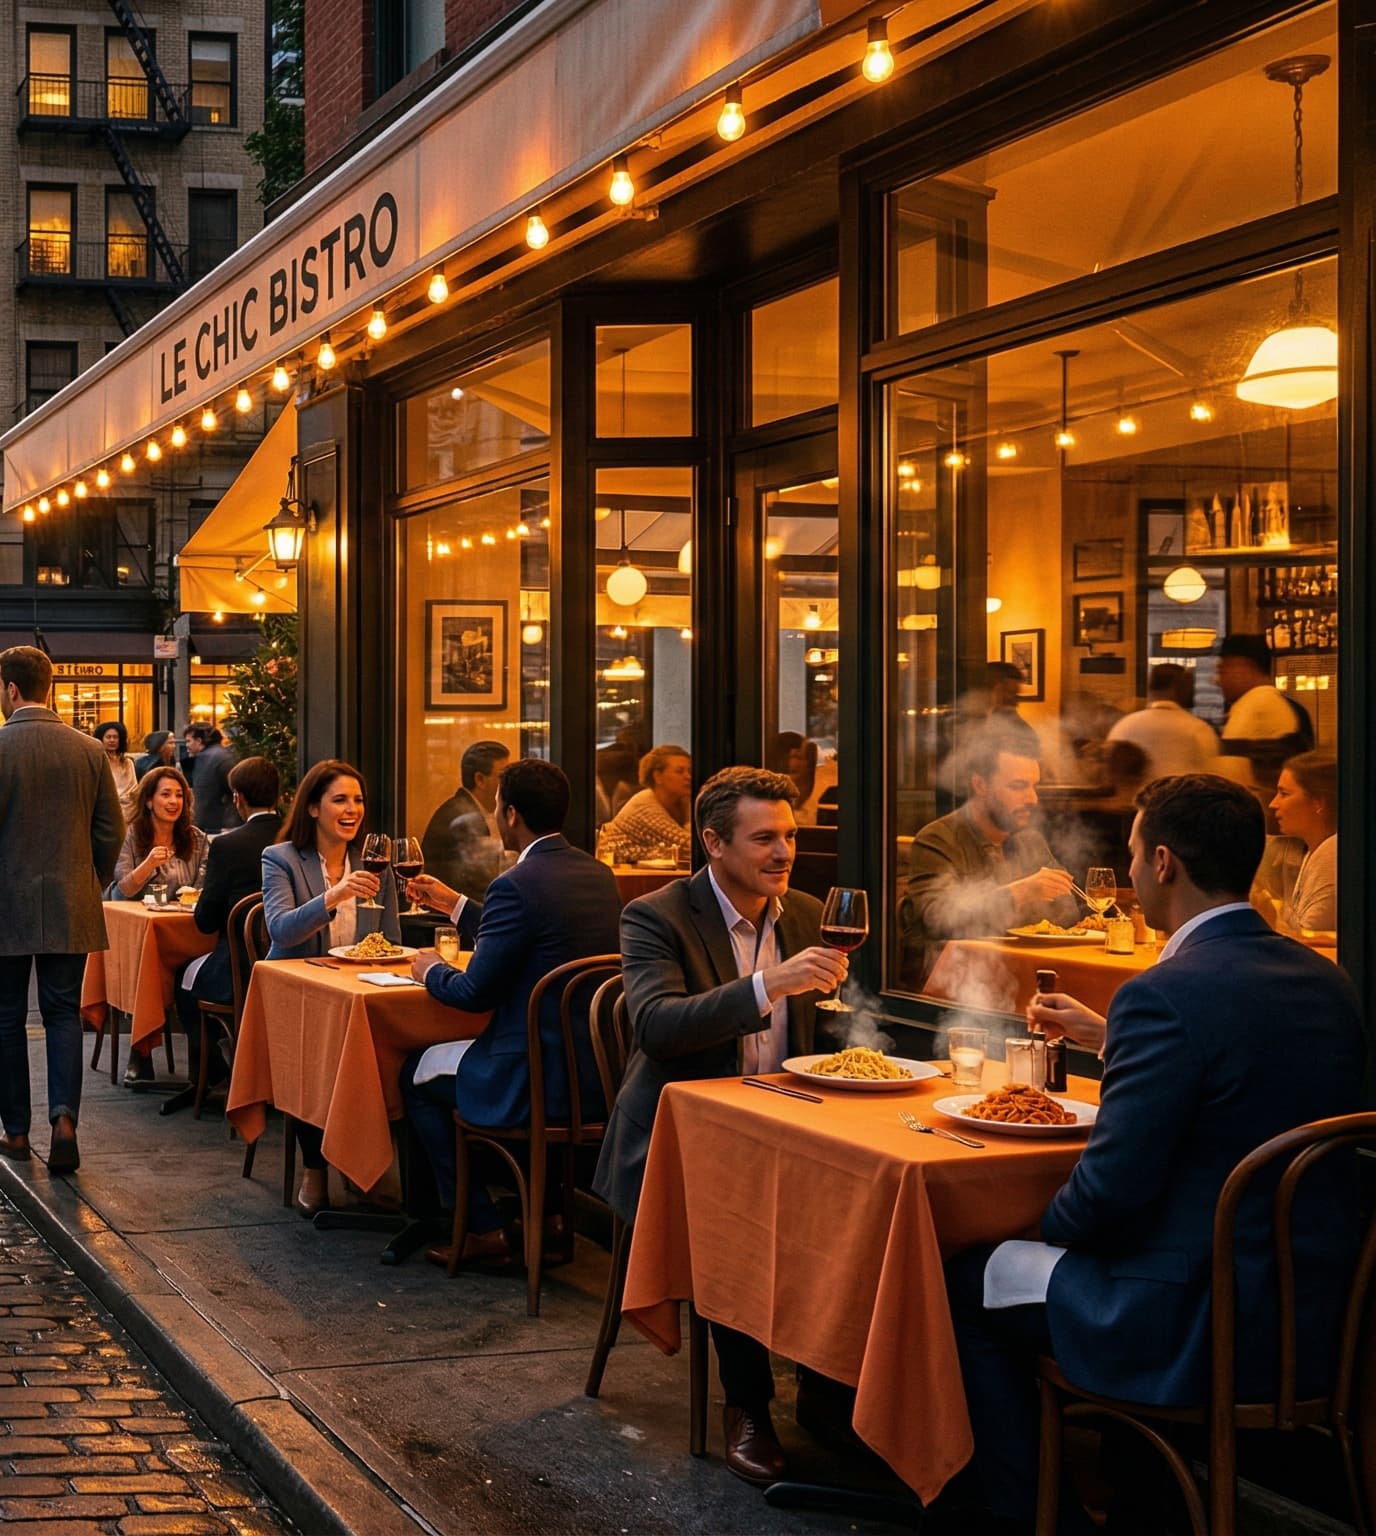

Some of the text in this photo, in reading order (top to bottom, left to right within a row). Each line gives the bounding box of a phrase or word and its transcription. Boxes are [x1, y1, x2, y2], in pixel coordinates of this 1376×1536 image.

[160, 192, 398, 405] LE CHIC BISTRO
